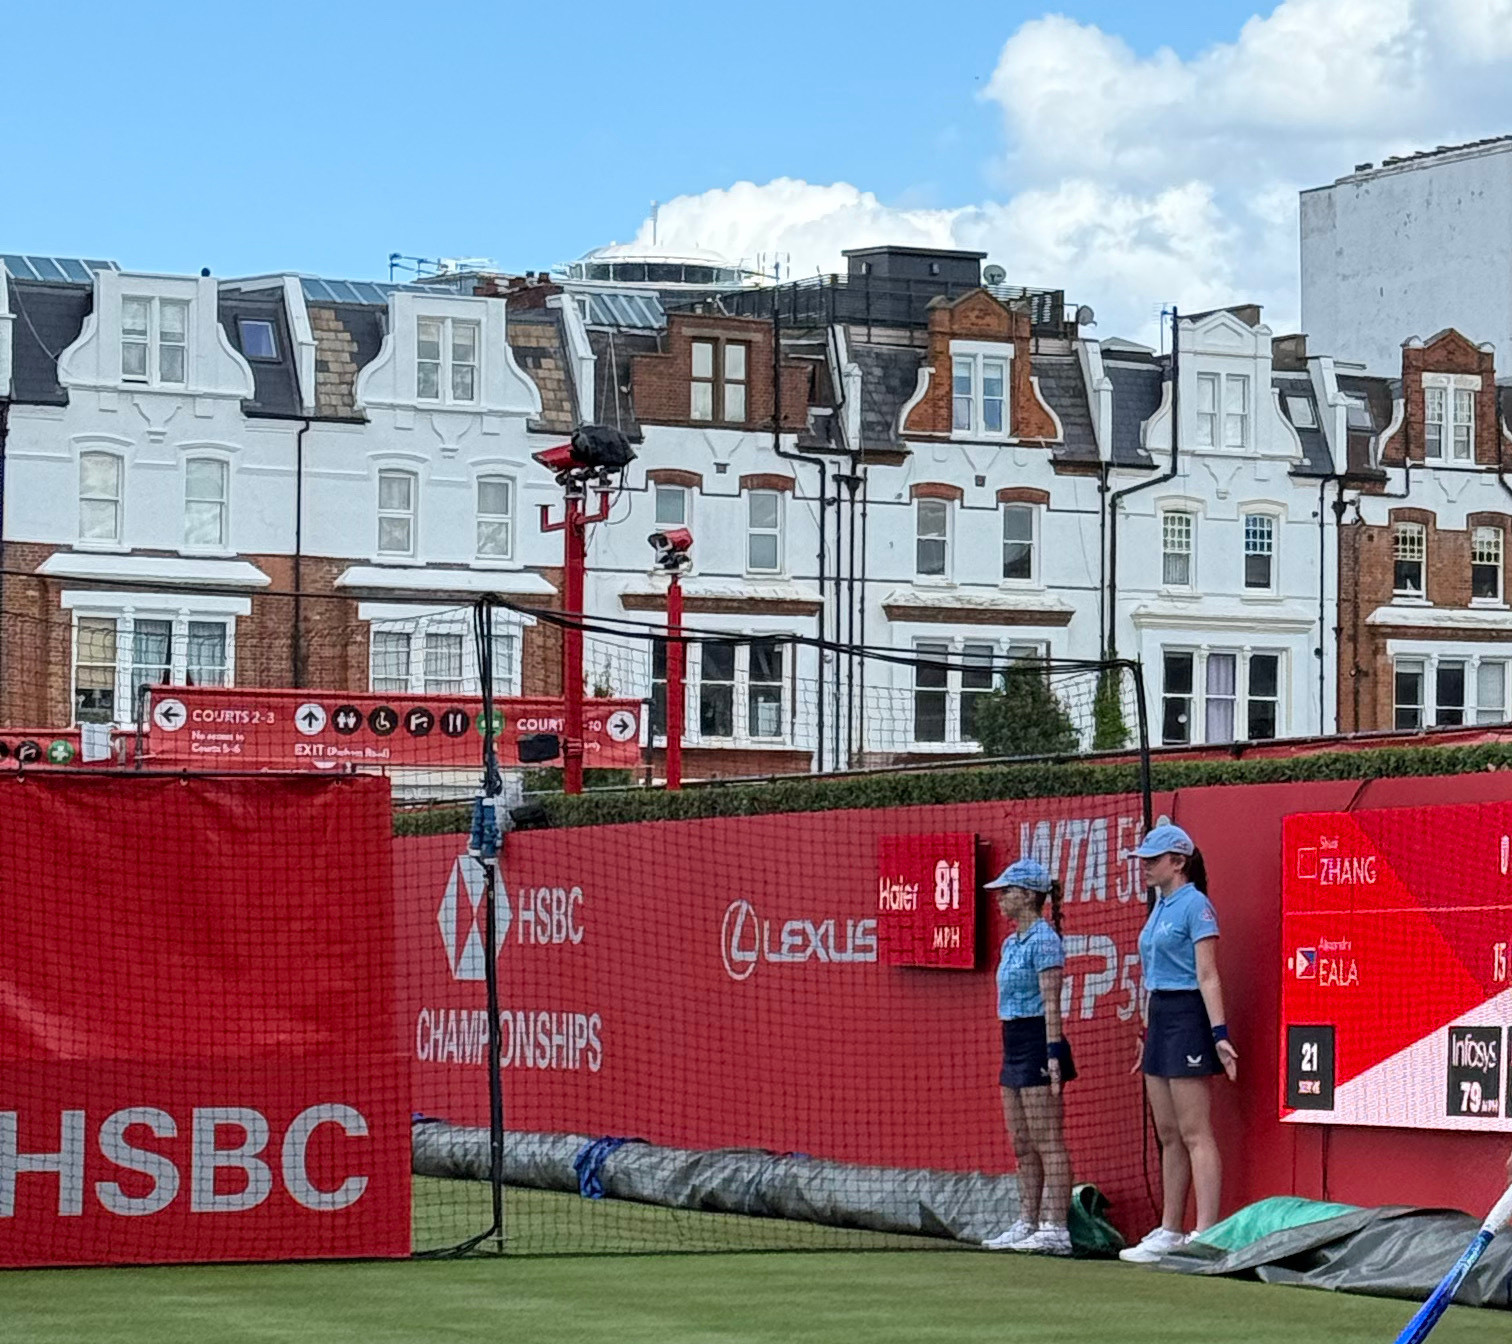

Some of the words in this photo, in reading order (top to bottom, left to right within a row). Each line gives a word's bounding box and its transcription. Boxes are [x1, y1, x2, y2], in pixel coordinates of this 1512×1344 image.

[192, 709, 250, 724] COURTS
[251, 710, 275, 724] 2-3
[294, 743, 325, 757] EXIT
[879, 874, 919, 911] Haier
[934, 859, 960, 911] 81
[1319, 856, 1377, 886] ZHANG
[518, 886, 585, 946] HSBC
[763, 918, 878, 963] LEXUS
[932, 926, 960, 950] MPH
[1318, 958, 1360, 987] EALA
[416, 1007, 603, 1073] CHAMPONSHIPS
[1451, 1033, 1497, 1074] Infosys
[1301, 1042, 1318, 1072] 21
[1459, 1081, 1482, 1113] 79
[0, 1102, 369, 1217] HSBC
